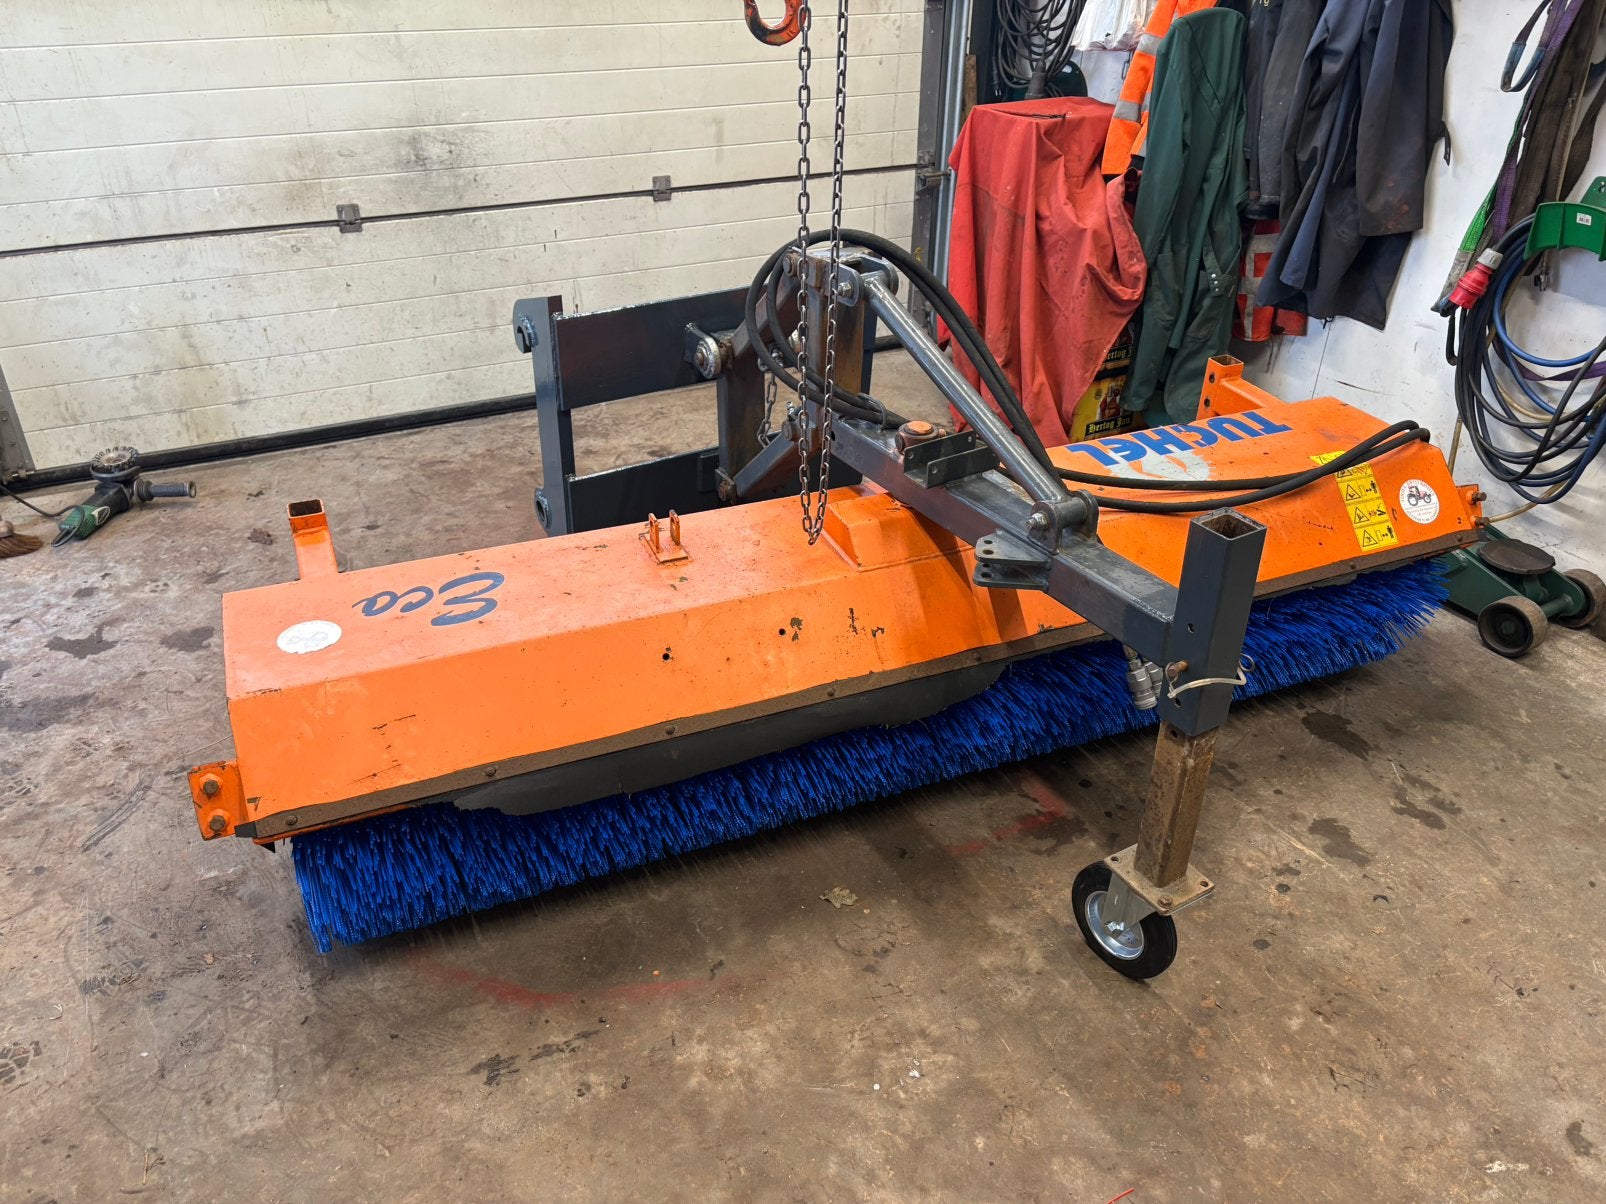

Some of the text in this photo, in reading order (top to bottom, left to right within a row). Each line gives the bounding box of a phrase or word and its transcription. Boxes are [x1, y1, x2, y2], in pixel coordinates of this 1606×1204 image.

[1106, 350, 1126, 360] ertog
[1065, 411, 1293, 467] TUCHEL
[1088, 416, 1130, 433] Hertog Jan
[352, 571, 505, 627] Eco
